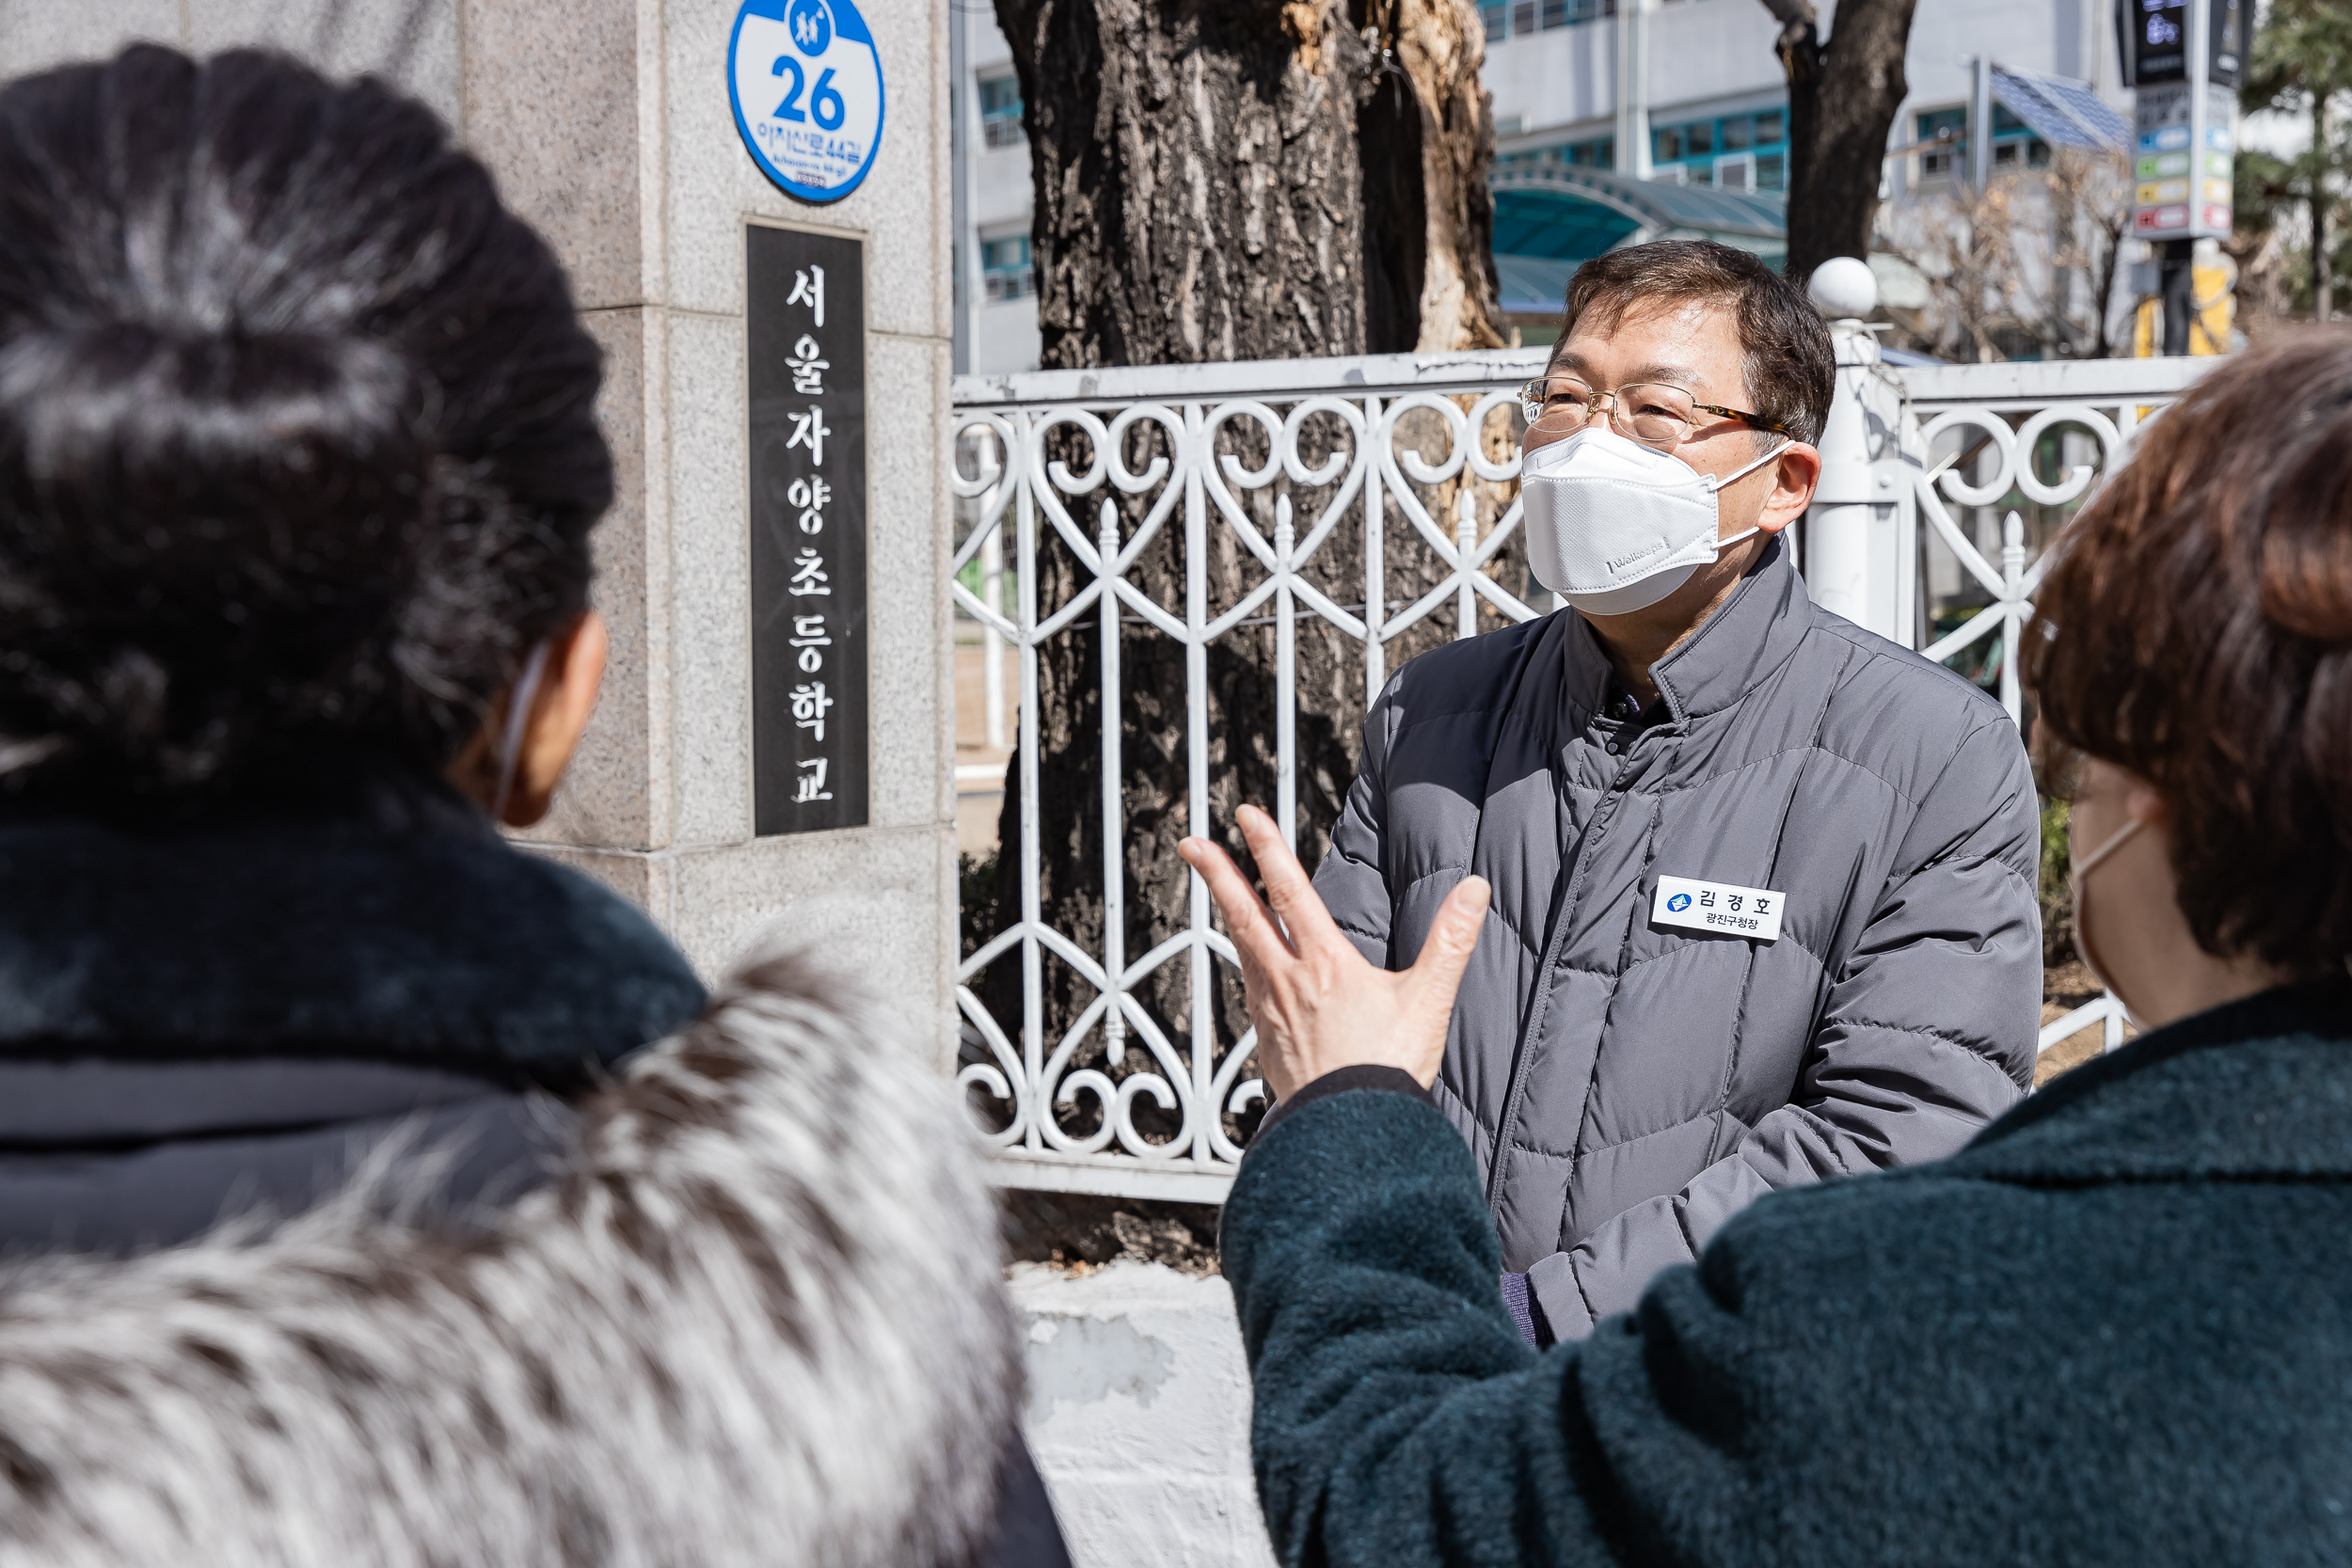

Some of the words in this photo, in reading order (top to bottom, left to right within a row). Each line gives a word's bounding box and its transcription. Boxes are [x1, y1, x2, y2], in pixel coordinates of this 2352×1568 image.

[771, 55, 845, 132] 26
[784, 262, 835, 805] 서울자양초등학교
[1706, 912, 1759, 930] 광진구청장
